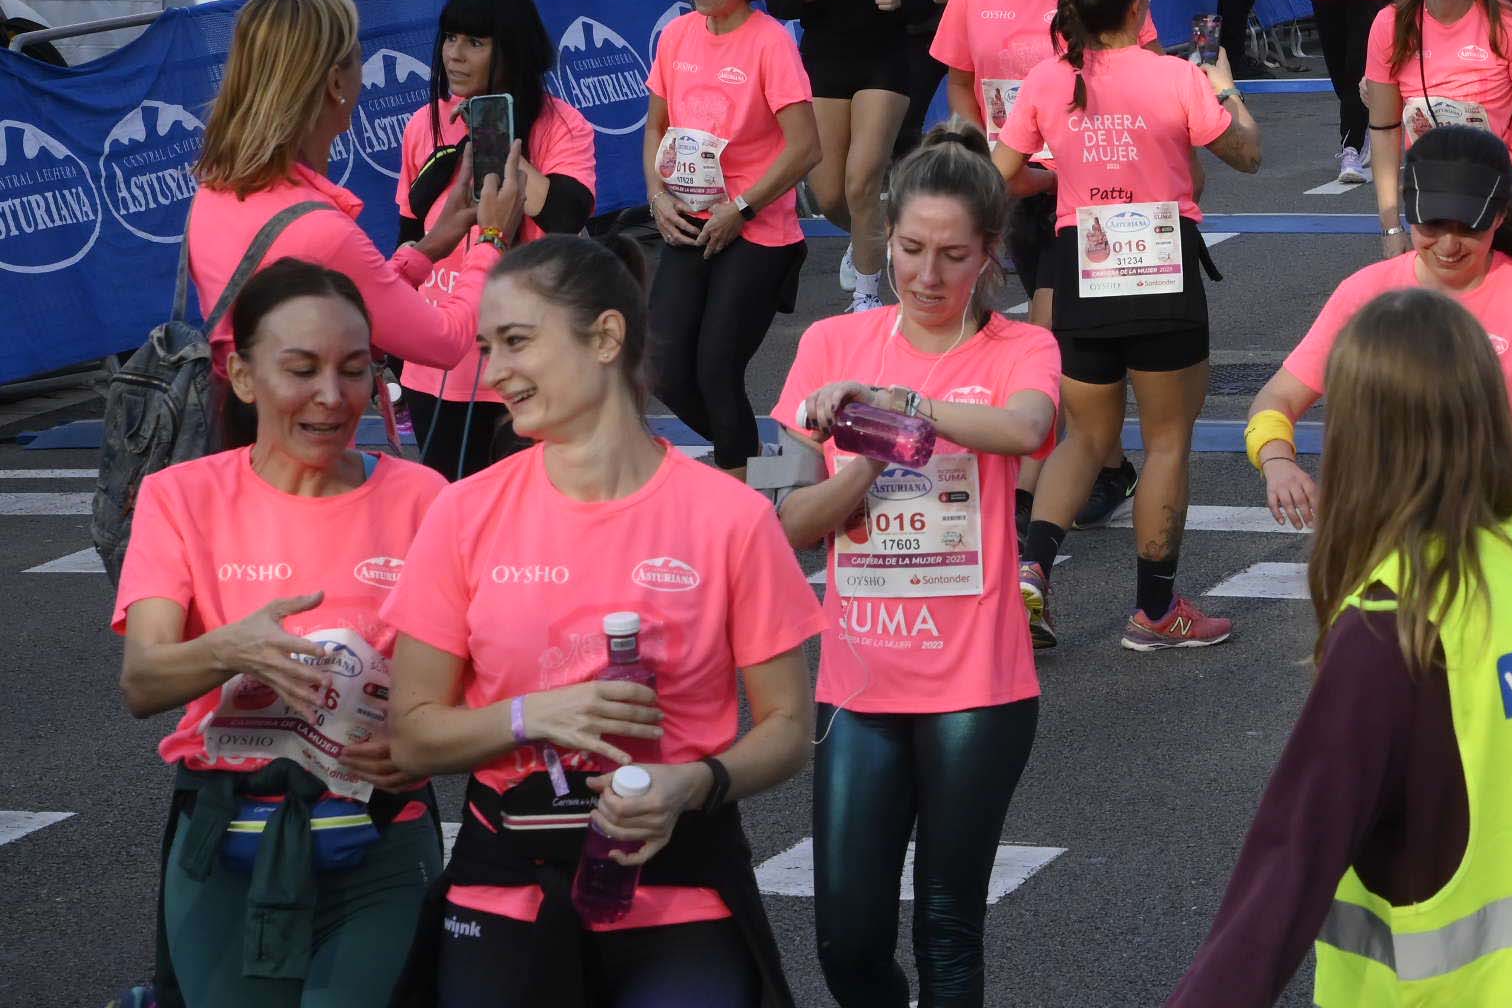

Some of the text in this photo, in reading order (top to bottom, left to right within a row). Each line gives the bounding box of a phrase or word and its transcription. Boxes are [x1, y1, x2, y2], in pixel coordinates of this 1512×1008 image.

[571, 66, 649, 110] ASTURIANA
[1068, 114, 1148, 132] CARRERA
[1085, 132, 1133, 146] DE LA
[1083, 146, 1139, 163] MUJER
[1090, 187, 1133, 203] Patty
[1113, 239, 1146, 253] 016
[1117, 256, 1143, 265] 31234
[937, 472, 967, 482] SUMA
[871, 482, 929, 494] ASTURIANA
[875, 512, 927, 532] 016
[881, 538, 921, 551] 17603
[851, 554, 966, 566] CARRERA DE LA MUJER 2023
[218, 563, 293, 582] OYSHO
[492, 565, 569, 583] OYSHO
[637, 569, 698, 588] ASTURIANA
[847, 574, 971, 587] OYSHO Santander
[219, 735, 274, 747] OYSHO
[310, 731, 338, 754] MUJER
